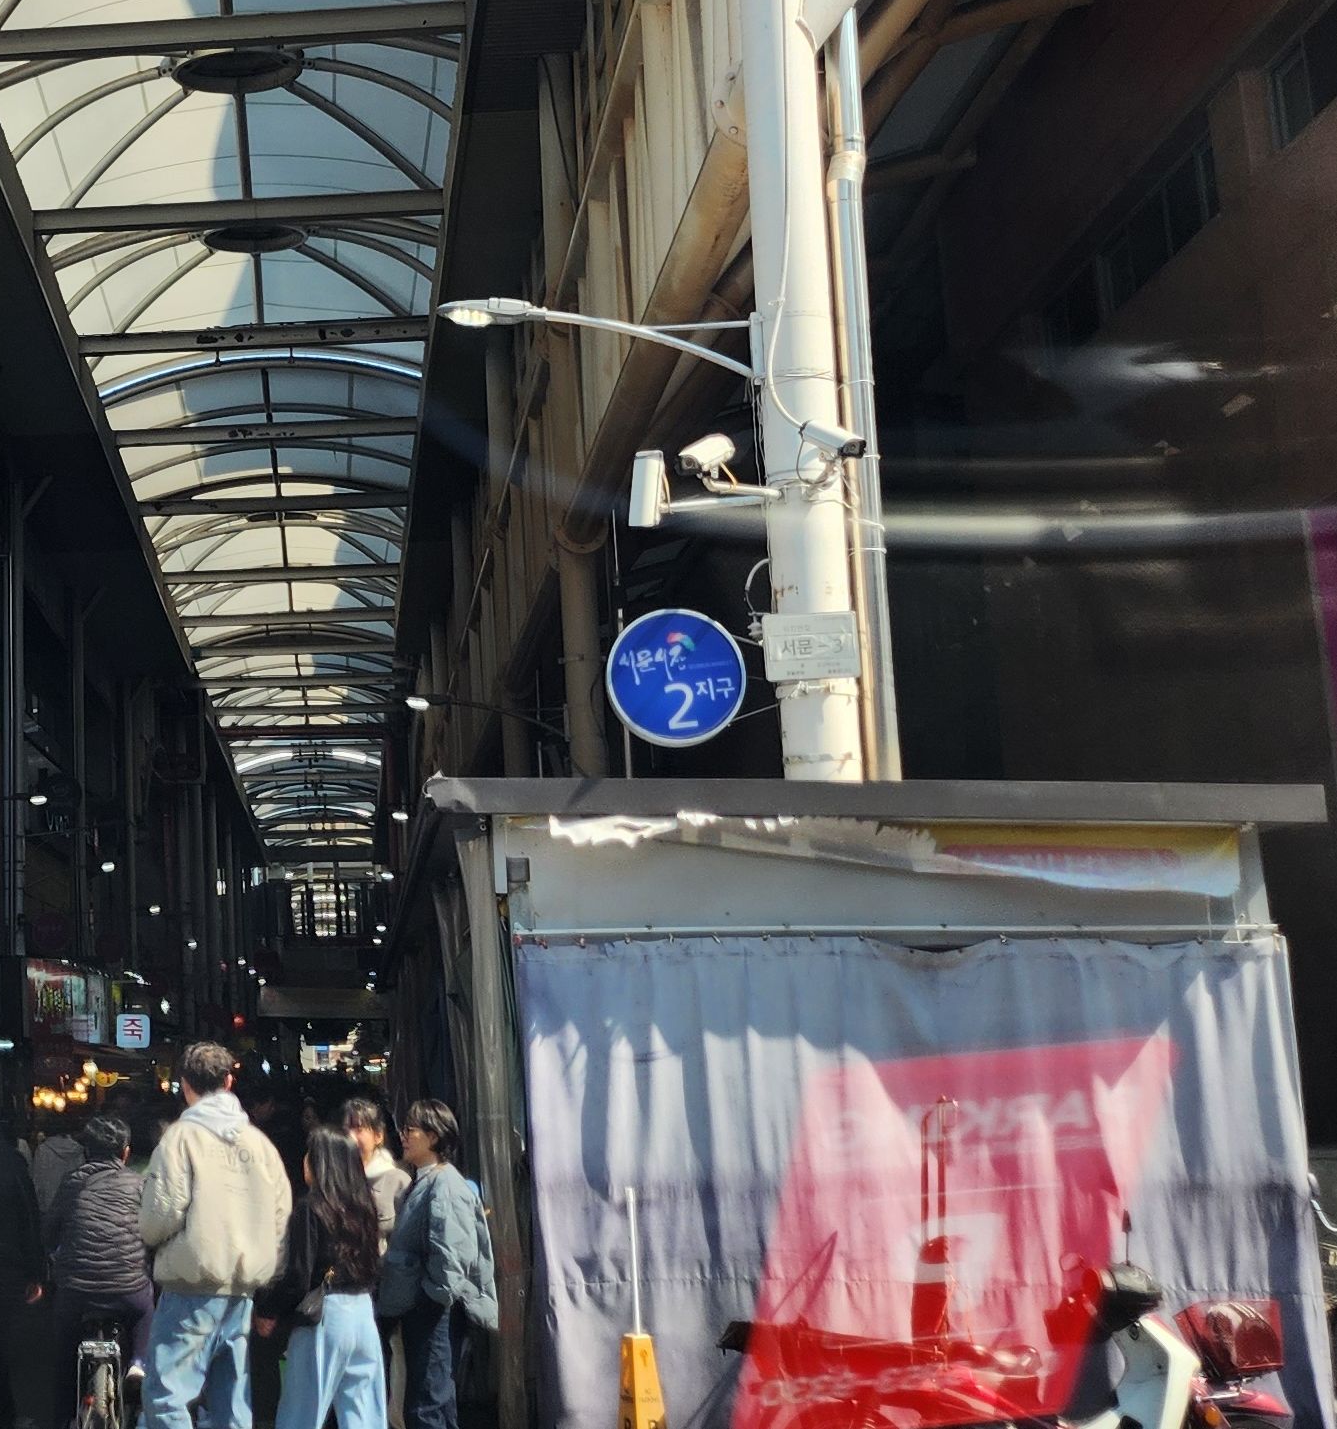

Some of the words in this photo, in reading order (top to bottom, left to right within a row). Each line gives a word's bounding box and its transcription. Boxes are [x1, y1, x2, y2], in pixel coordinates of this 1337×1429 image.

[619, 644, 686, 685] 서문시장
[664, 683, 699, 729] 2
[695, 677, 735, 701] 지구
[123, 1018, 143, 1041] 죽
